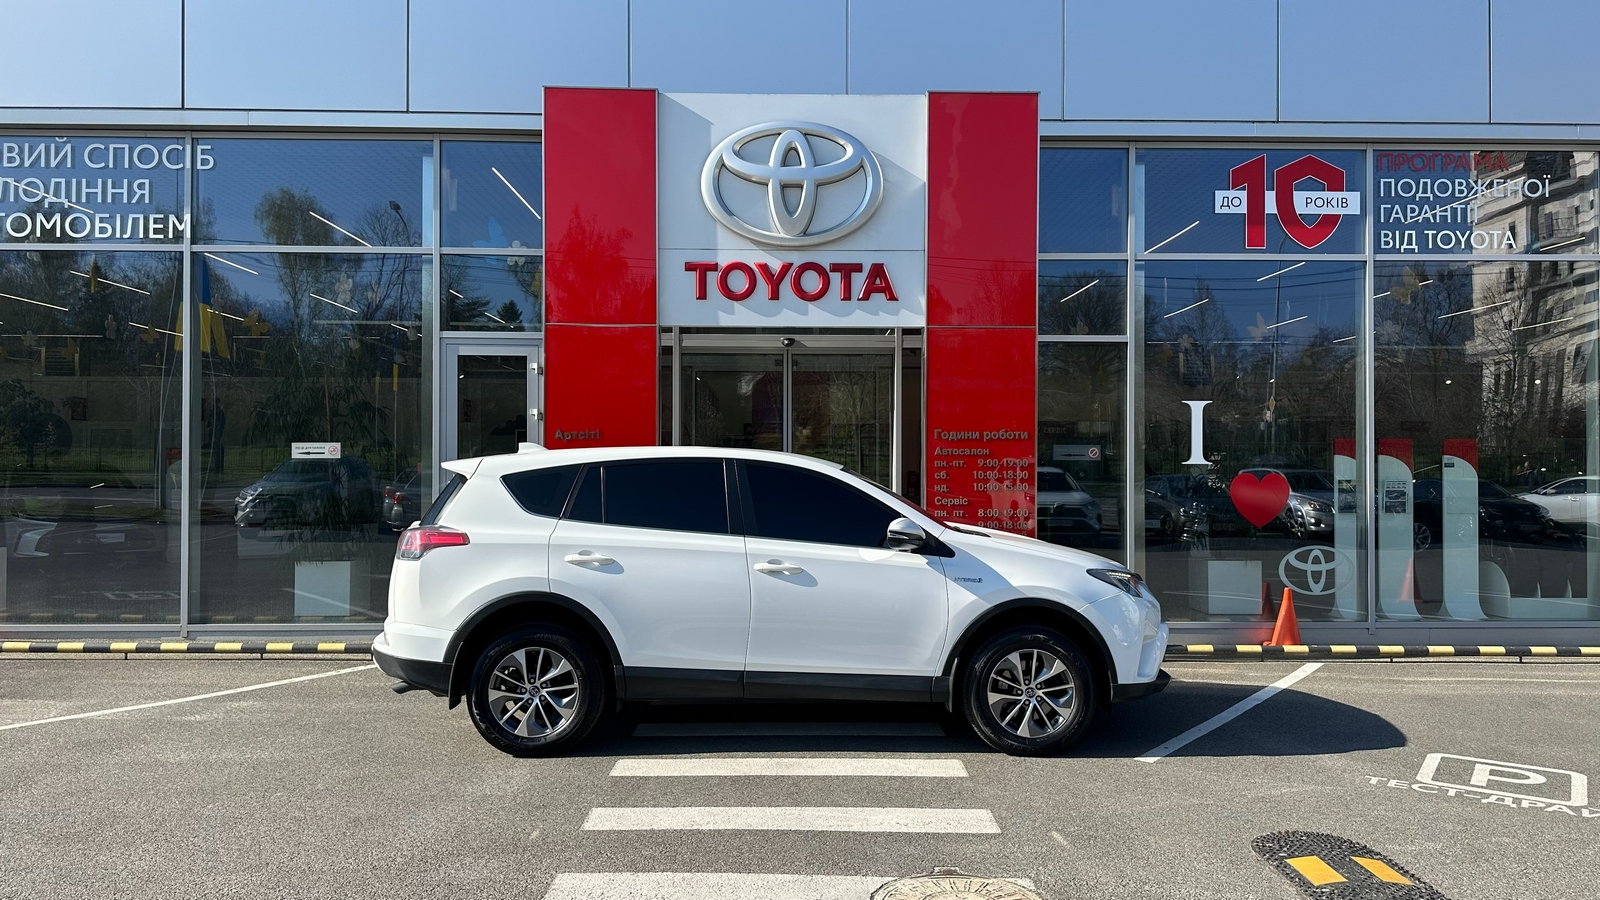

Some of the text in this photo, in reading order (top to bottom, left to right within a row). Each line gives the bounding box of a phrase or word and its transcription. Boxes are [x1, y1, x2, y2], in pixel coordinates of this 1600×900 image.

[83, 143, 215, 170] СПОСІБ
[1378, 152, 1509, 172] ПРОГРАМА
[1380, 174, 1551, 201] ПОДОВЖЕНОЇ
[1220, 153, 1349, 250] ДО 10 РОКІВ
[1380, 200, 1480, 223] ГАРАНТІЇ
[0, 212, 191, 239] ОМОБІЛЕМ
[1380, 230, 1517, 253] ВІД TOYOTA
[684, 261, 899, 302] TOYOTA
[934, 429, 1028, 441] Години роботи
[1181, 400, 1213, 465] I
[934, 447, 990, 456] Автосалон
[977, 459, 1029, 467] 9:00-19:00
[934, 471, 1029, 480] сб. 10:00-18:00
[934, 484, 950, 493] нд.
[934, 496, 968, 507] Сервіс
[1469, 763, 1547, 787] P
